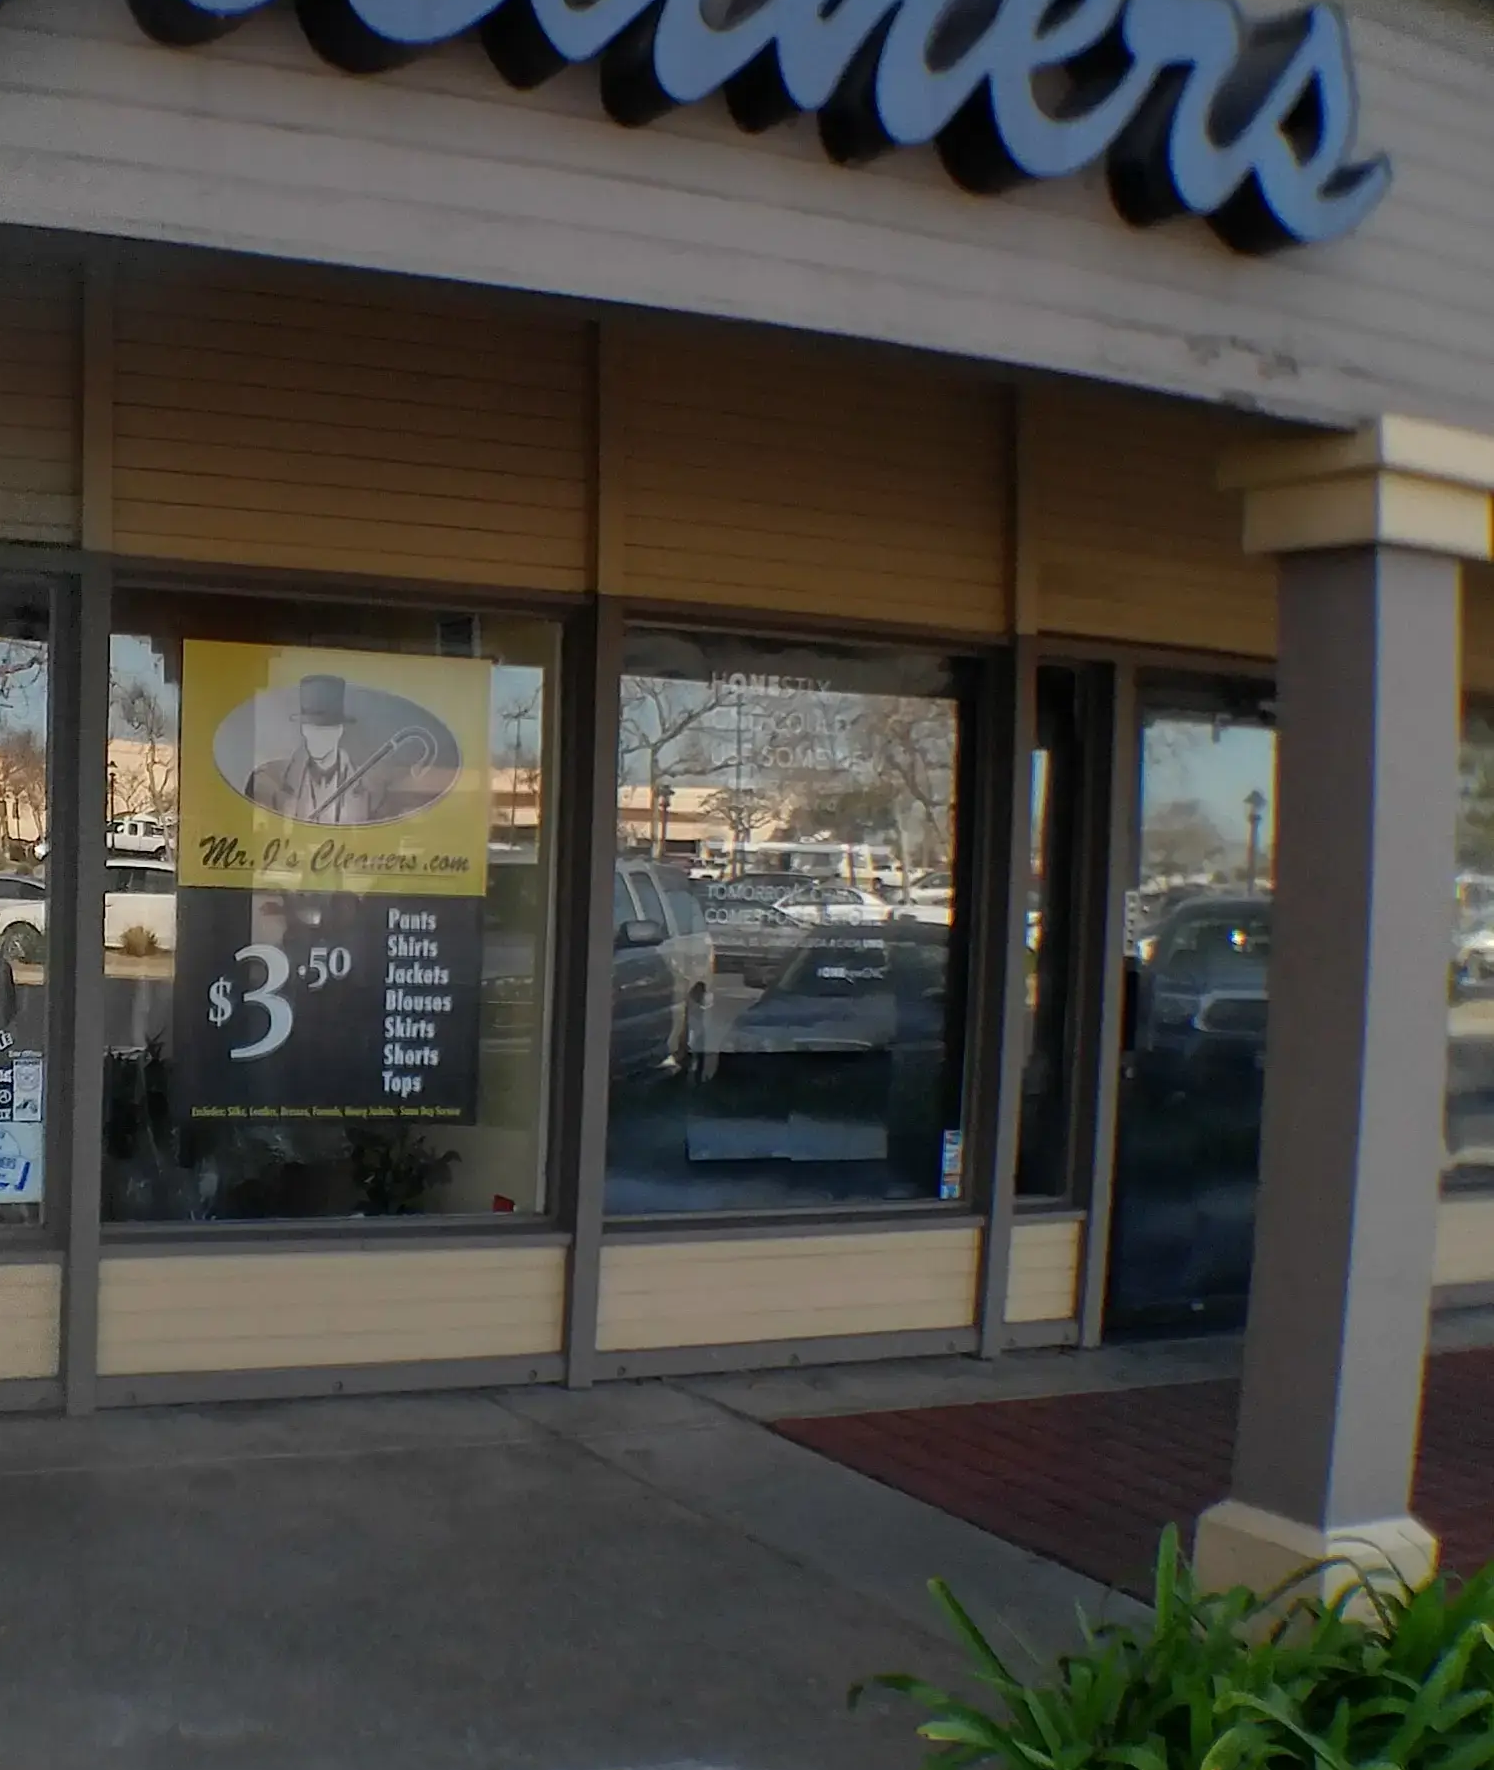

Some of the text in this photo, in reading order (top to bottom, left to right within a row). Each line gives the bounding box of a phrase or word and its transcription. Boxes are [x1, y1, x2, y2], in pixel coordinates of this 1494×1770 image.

[199, 835, 254, 868] Mr.
[388, 907, 437, 931] Pants
[387, 935, 438, 958] Shirts
[385, 962, 450, 985] Jackets
[385, 989, 452, 1012] Blouses
[384, 1015, 436, 1038] Skirts
[383, 1043, 439, 1066] Shorts
[382, 1070, 422, 1097] Tops
